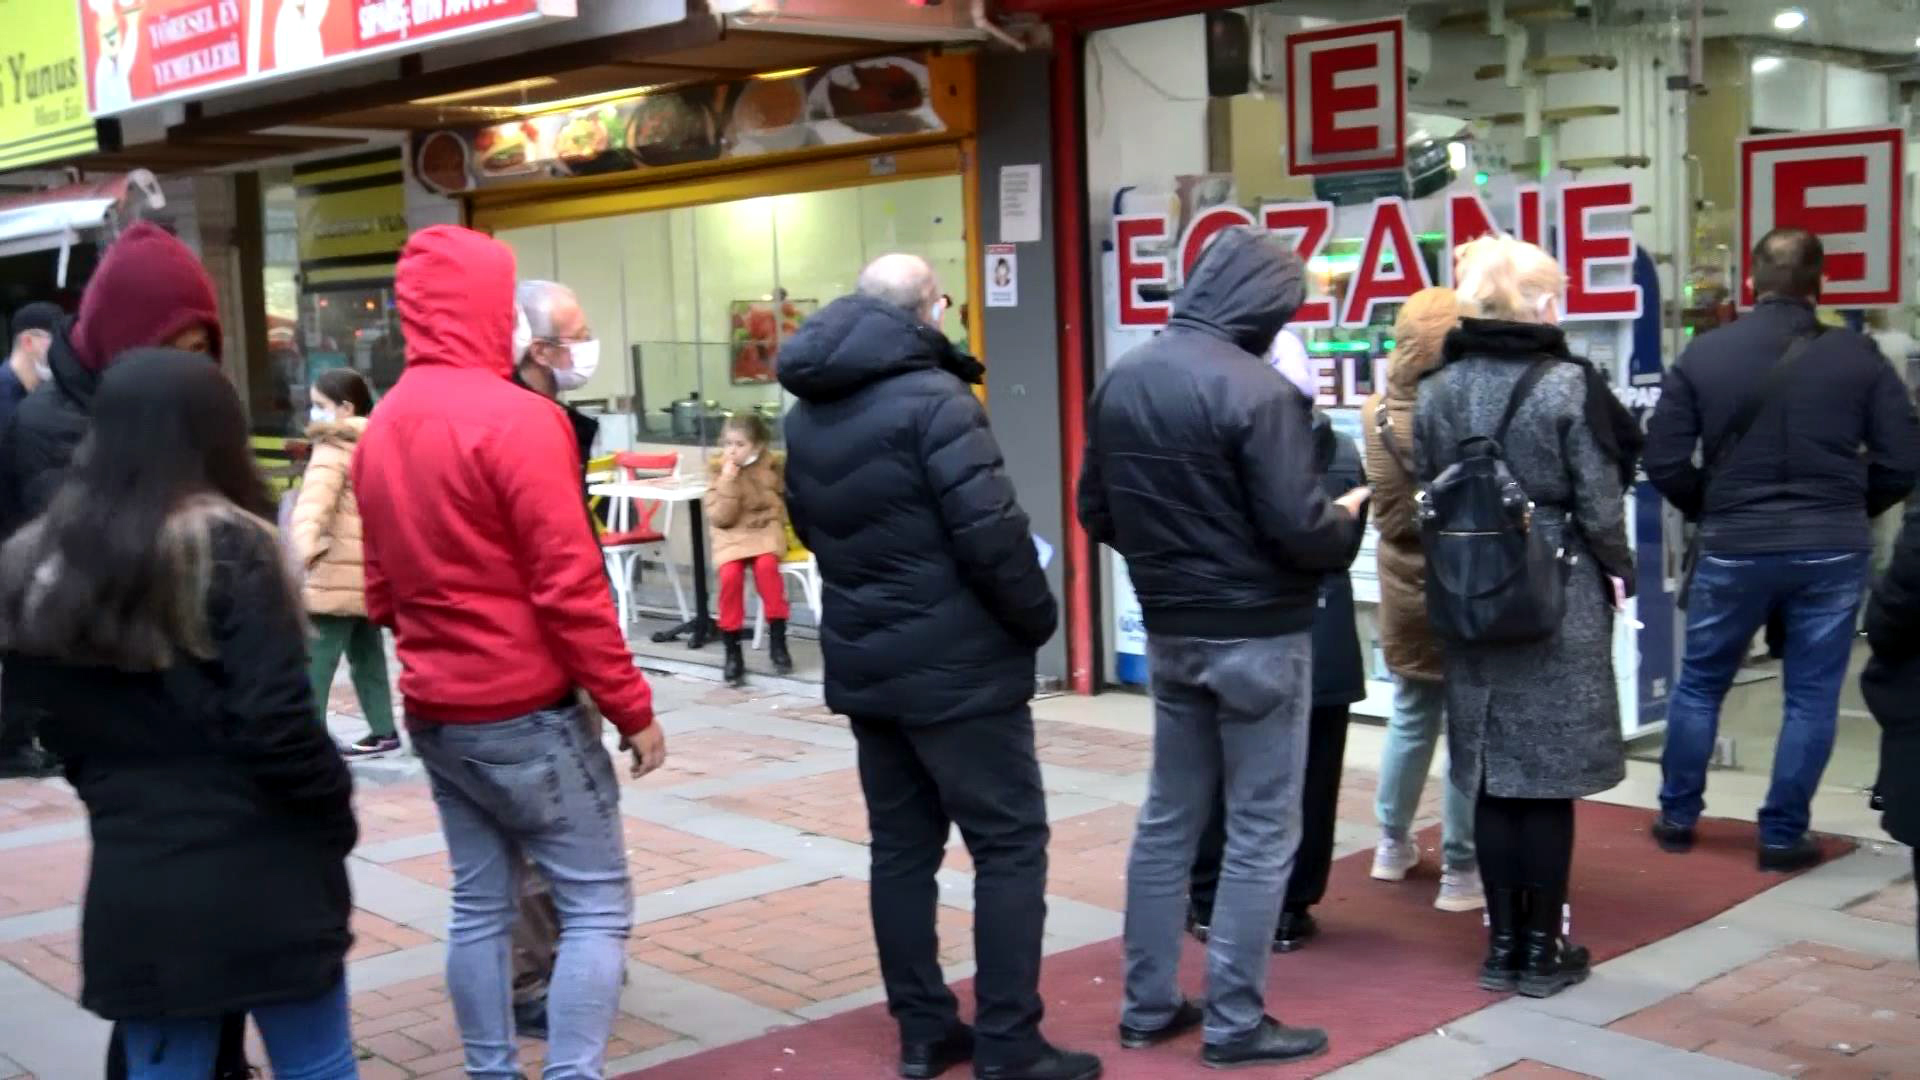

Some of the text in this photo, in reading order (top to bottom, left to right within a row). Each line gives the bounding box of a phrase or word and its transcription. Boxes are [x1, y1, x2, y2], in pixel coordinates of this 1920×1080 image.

[8, 53, 77, 104] Yunus
[1310, 43, 1379, 155] E
[1116, 180, 1641, 329] ECZANE
[1774, 155, 1867, 283] E
